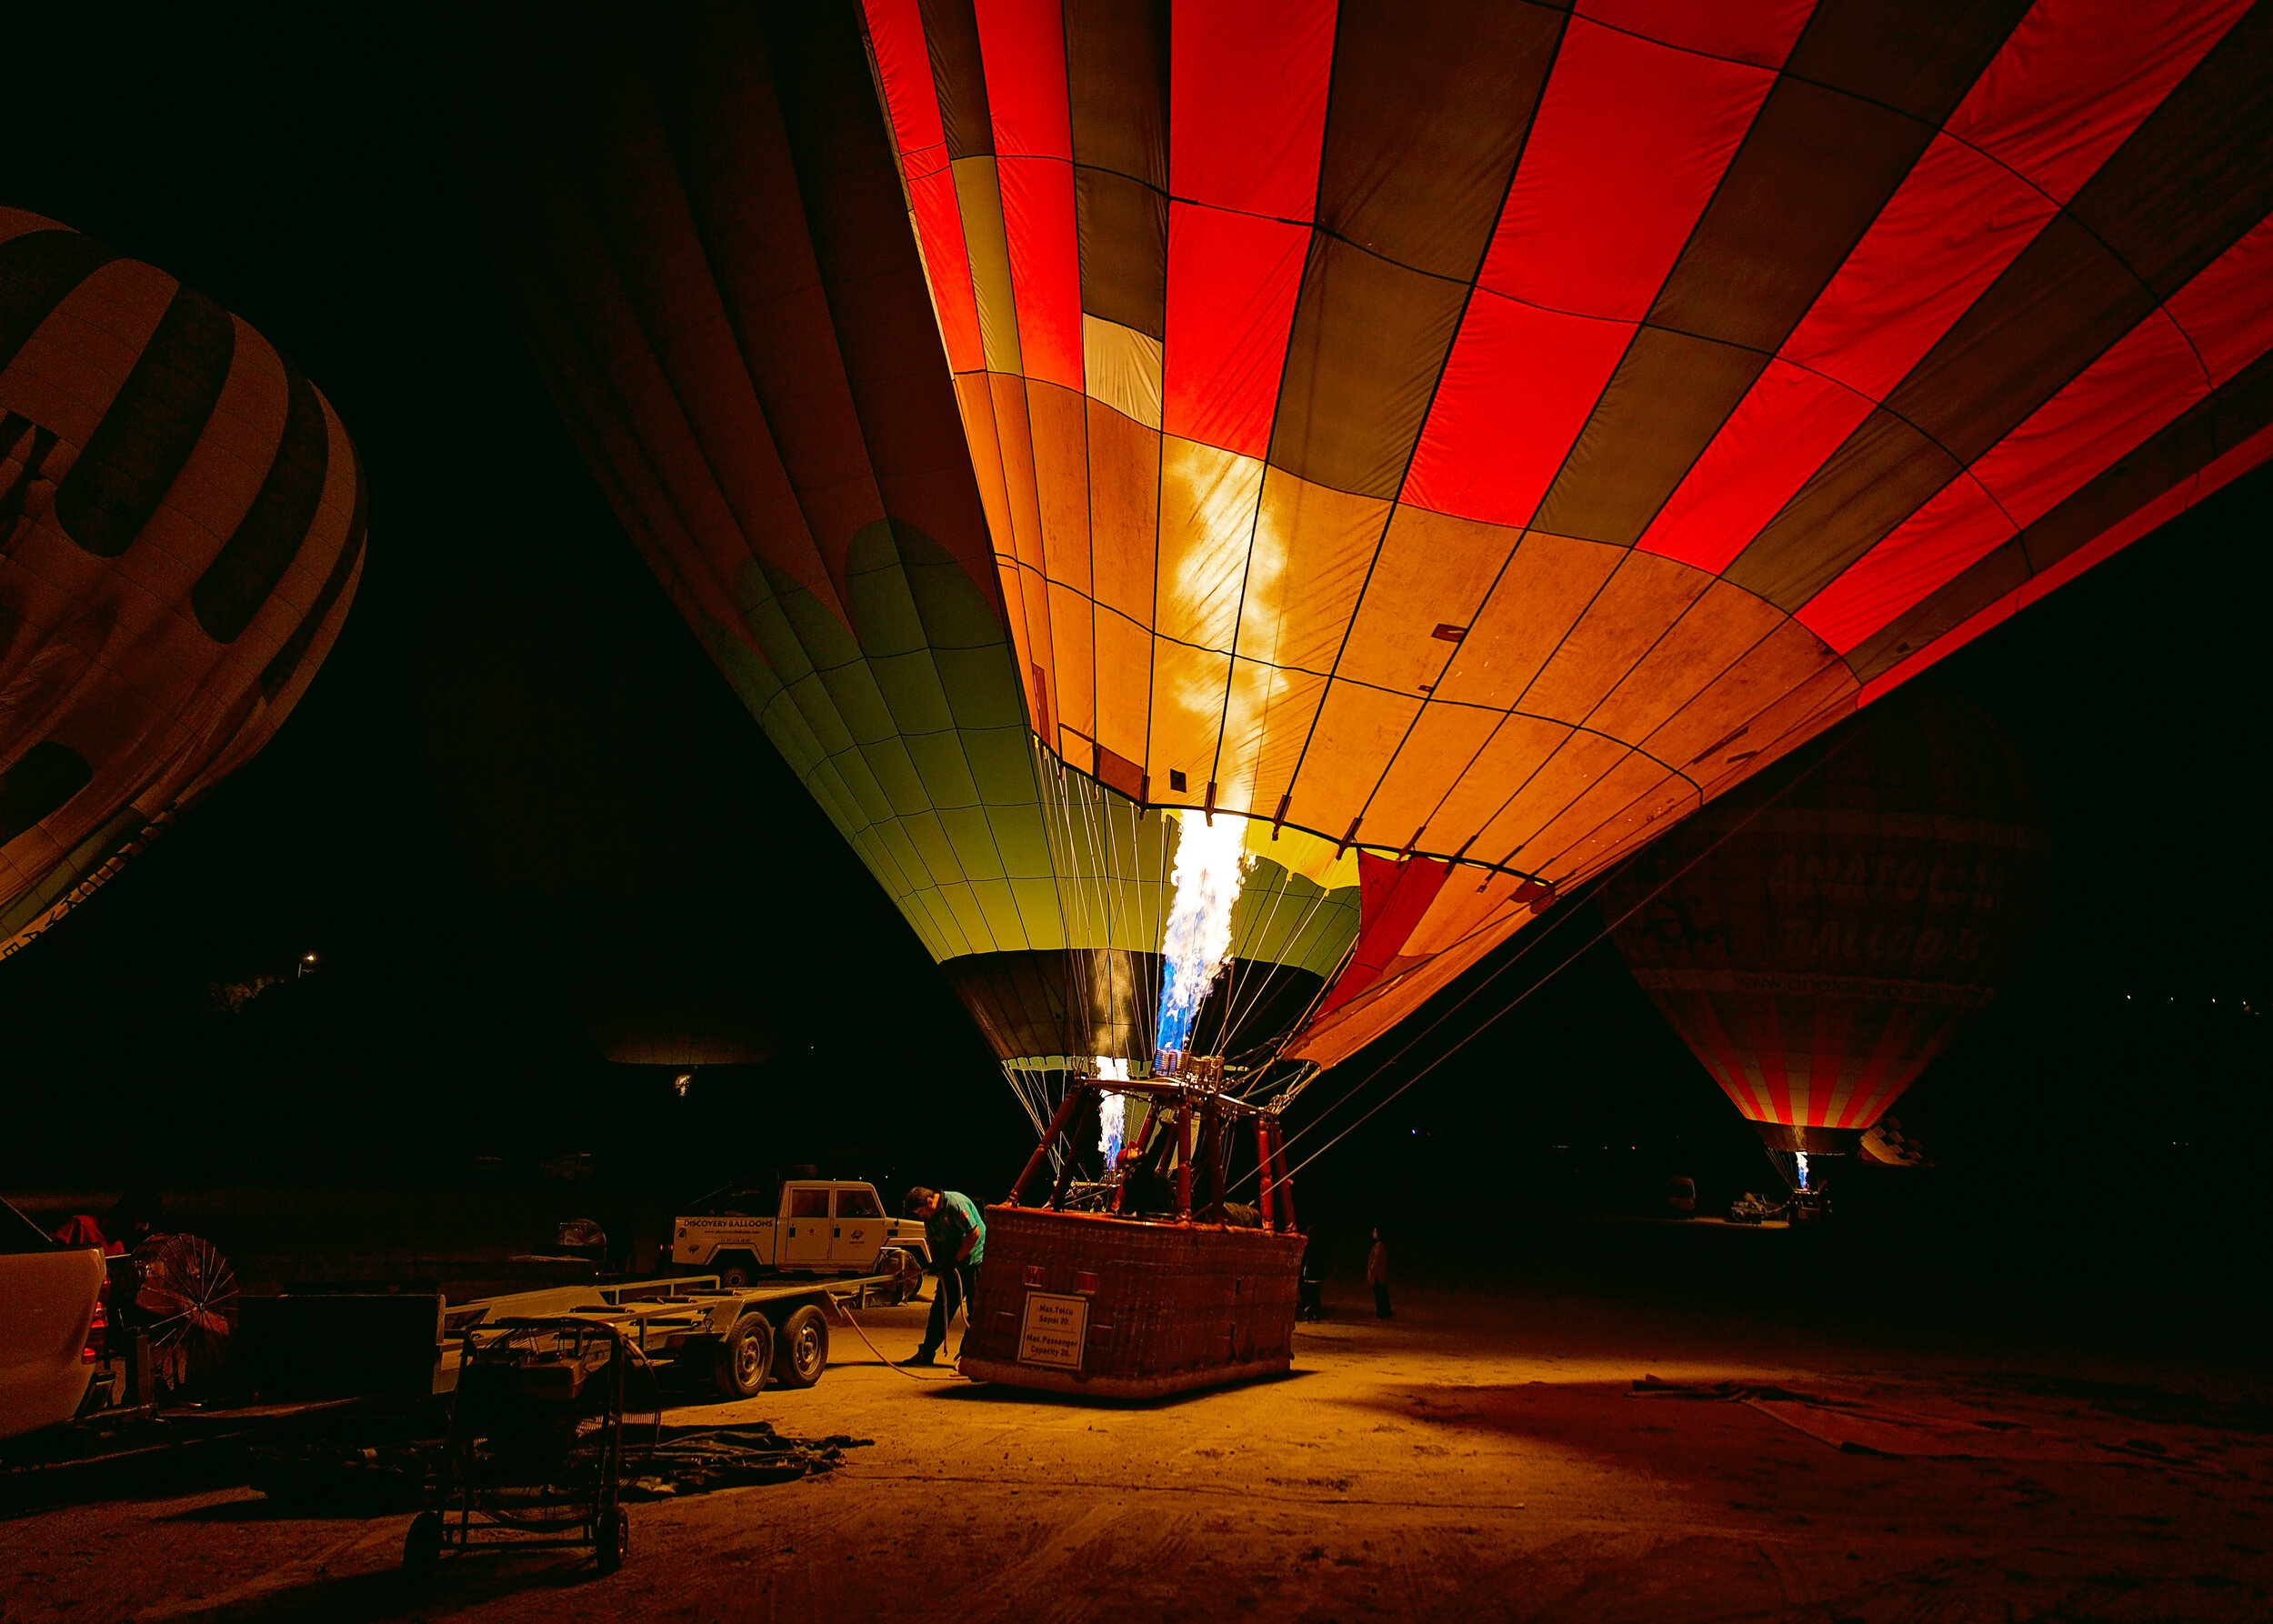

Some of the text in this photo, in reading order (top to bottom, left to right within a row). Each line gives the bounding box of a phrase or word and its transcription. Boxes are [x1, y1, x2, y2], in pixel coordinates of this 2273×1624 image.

[685, 1219, 773, 1228] DISCOVERY BALLOONS
[1030, 1345, 1059, 1358] Capacity
